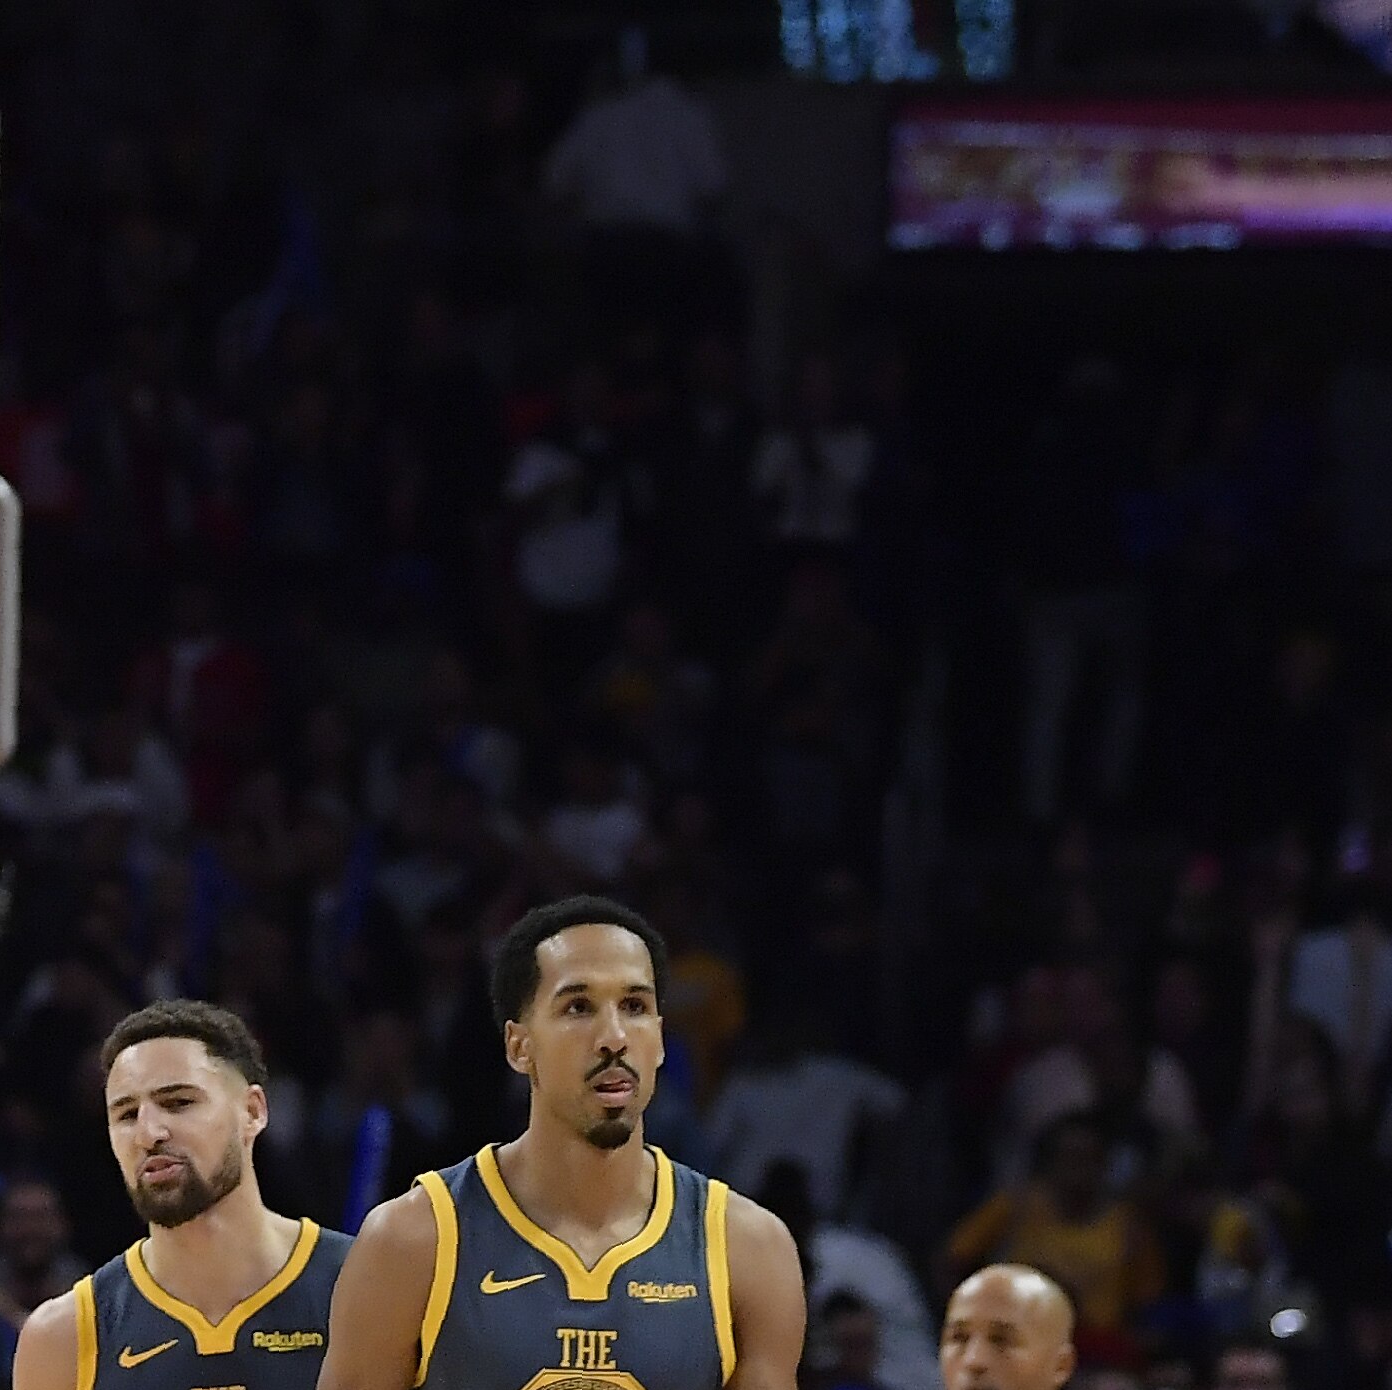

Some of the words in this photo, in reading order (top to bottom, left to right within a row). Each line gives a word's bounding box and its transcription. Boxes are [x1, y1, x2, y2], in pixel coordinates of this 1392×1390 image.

[627, 1281, 697, 1304] Rakuten
[252, 1331, 323, 1352] Rakuten
[556, 1328, 618, 1369] THE
